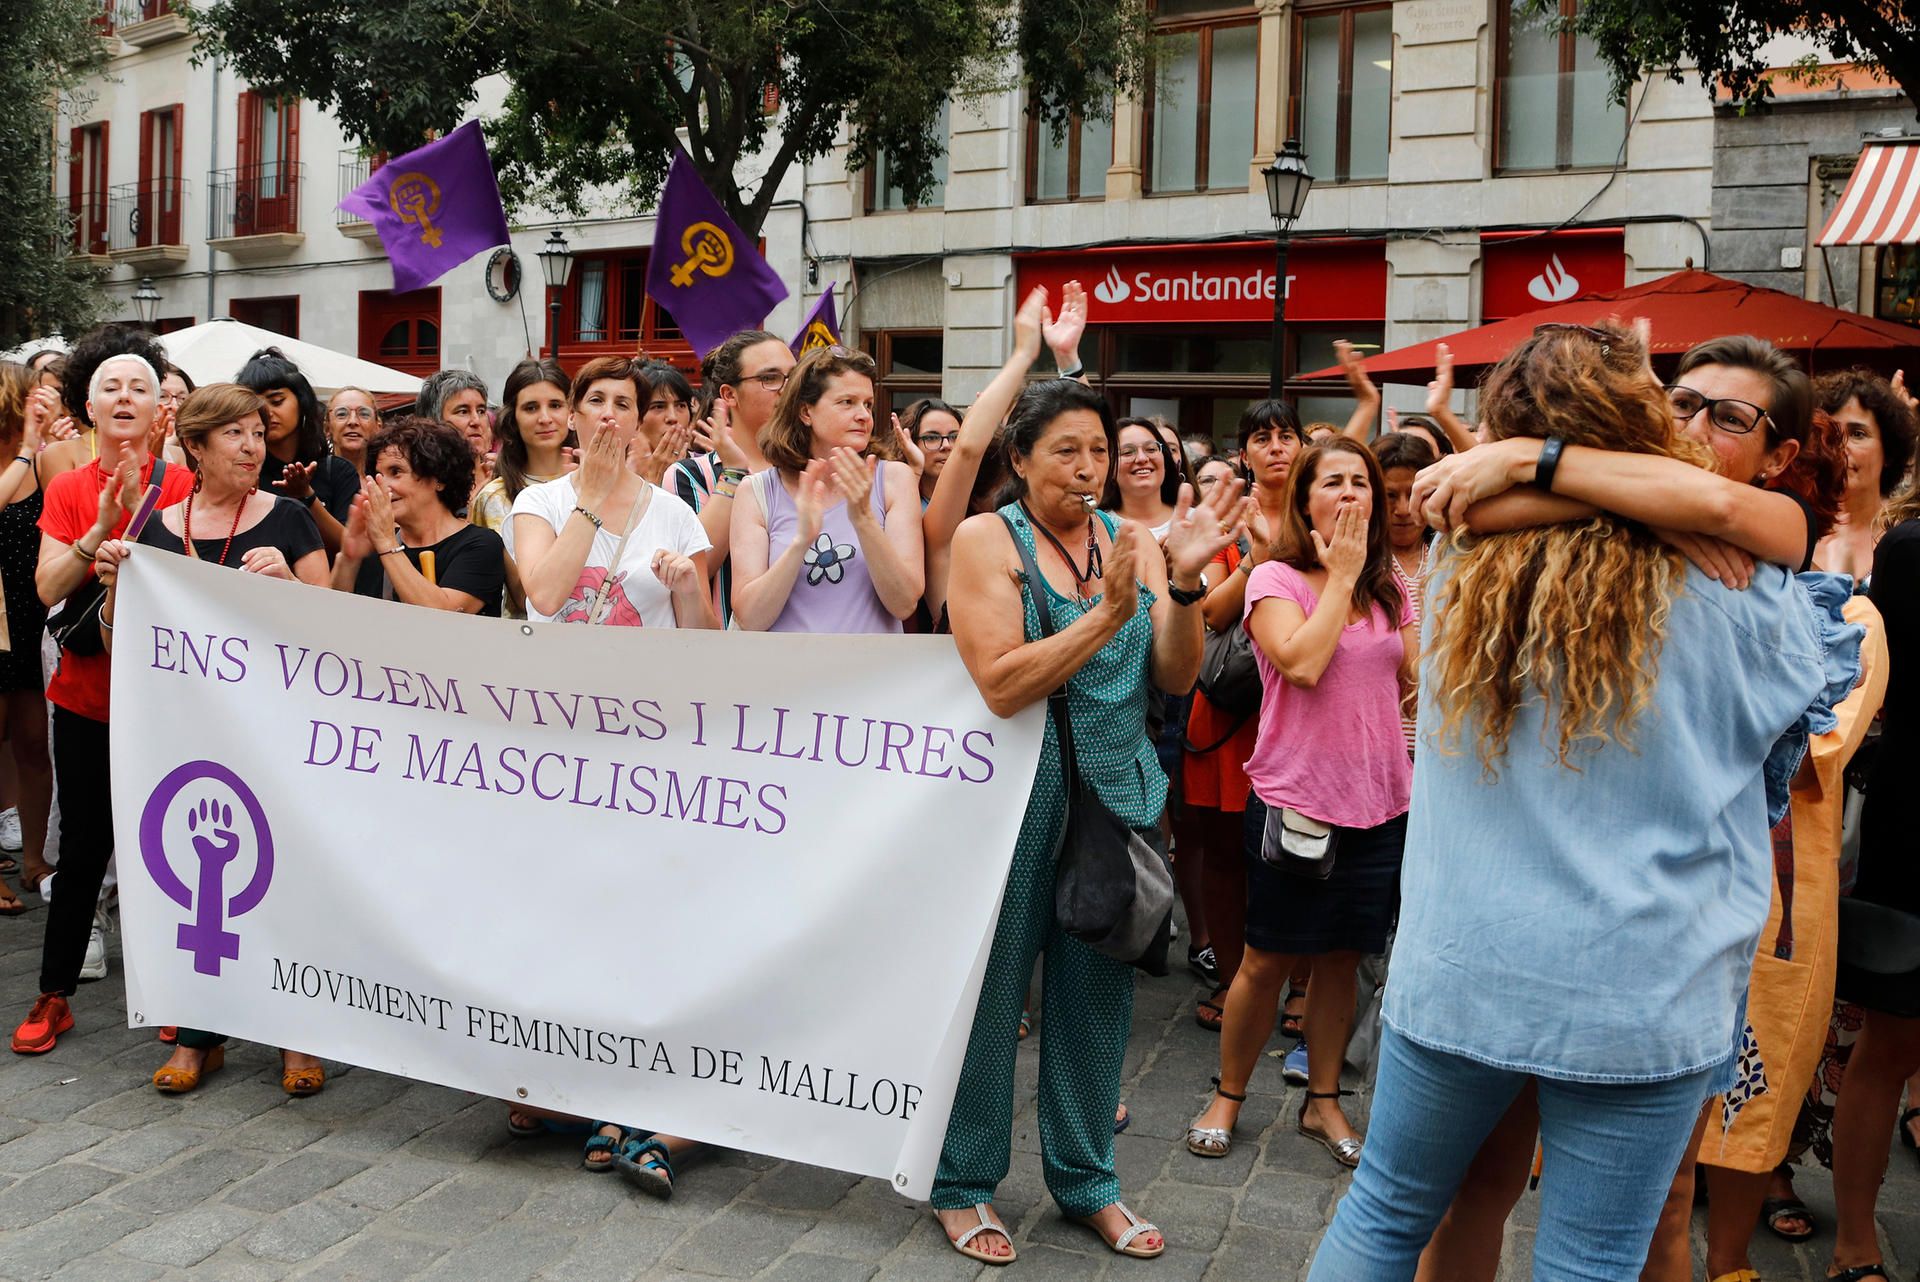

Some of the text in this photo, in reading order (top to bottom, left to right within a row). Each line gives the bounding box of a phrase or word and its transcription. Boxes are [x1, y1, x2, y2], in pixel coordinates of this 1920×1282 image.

[1134, 269, 1296, 302] Santander
[151, 626, 995, 784] ENS VOLEM VIVES I LLIURES
[304, 719, 787, 835] DE MASCLISMES
[272, 958, 453, 1031] MOVIMENT
[466, 1006, 677, 1075] FEMINISTA
[692, 1047, 744, 1086] DE
